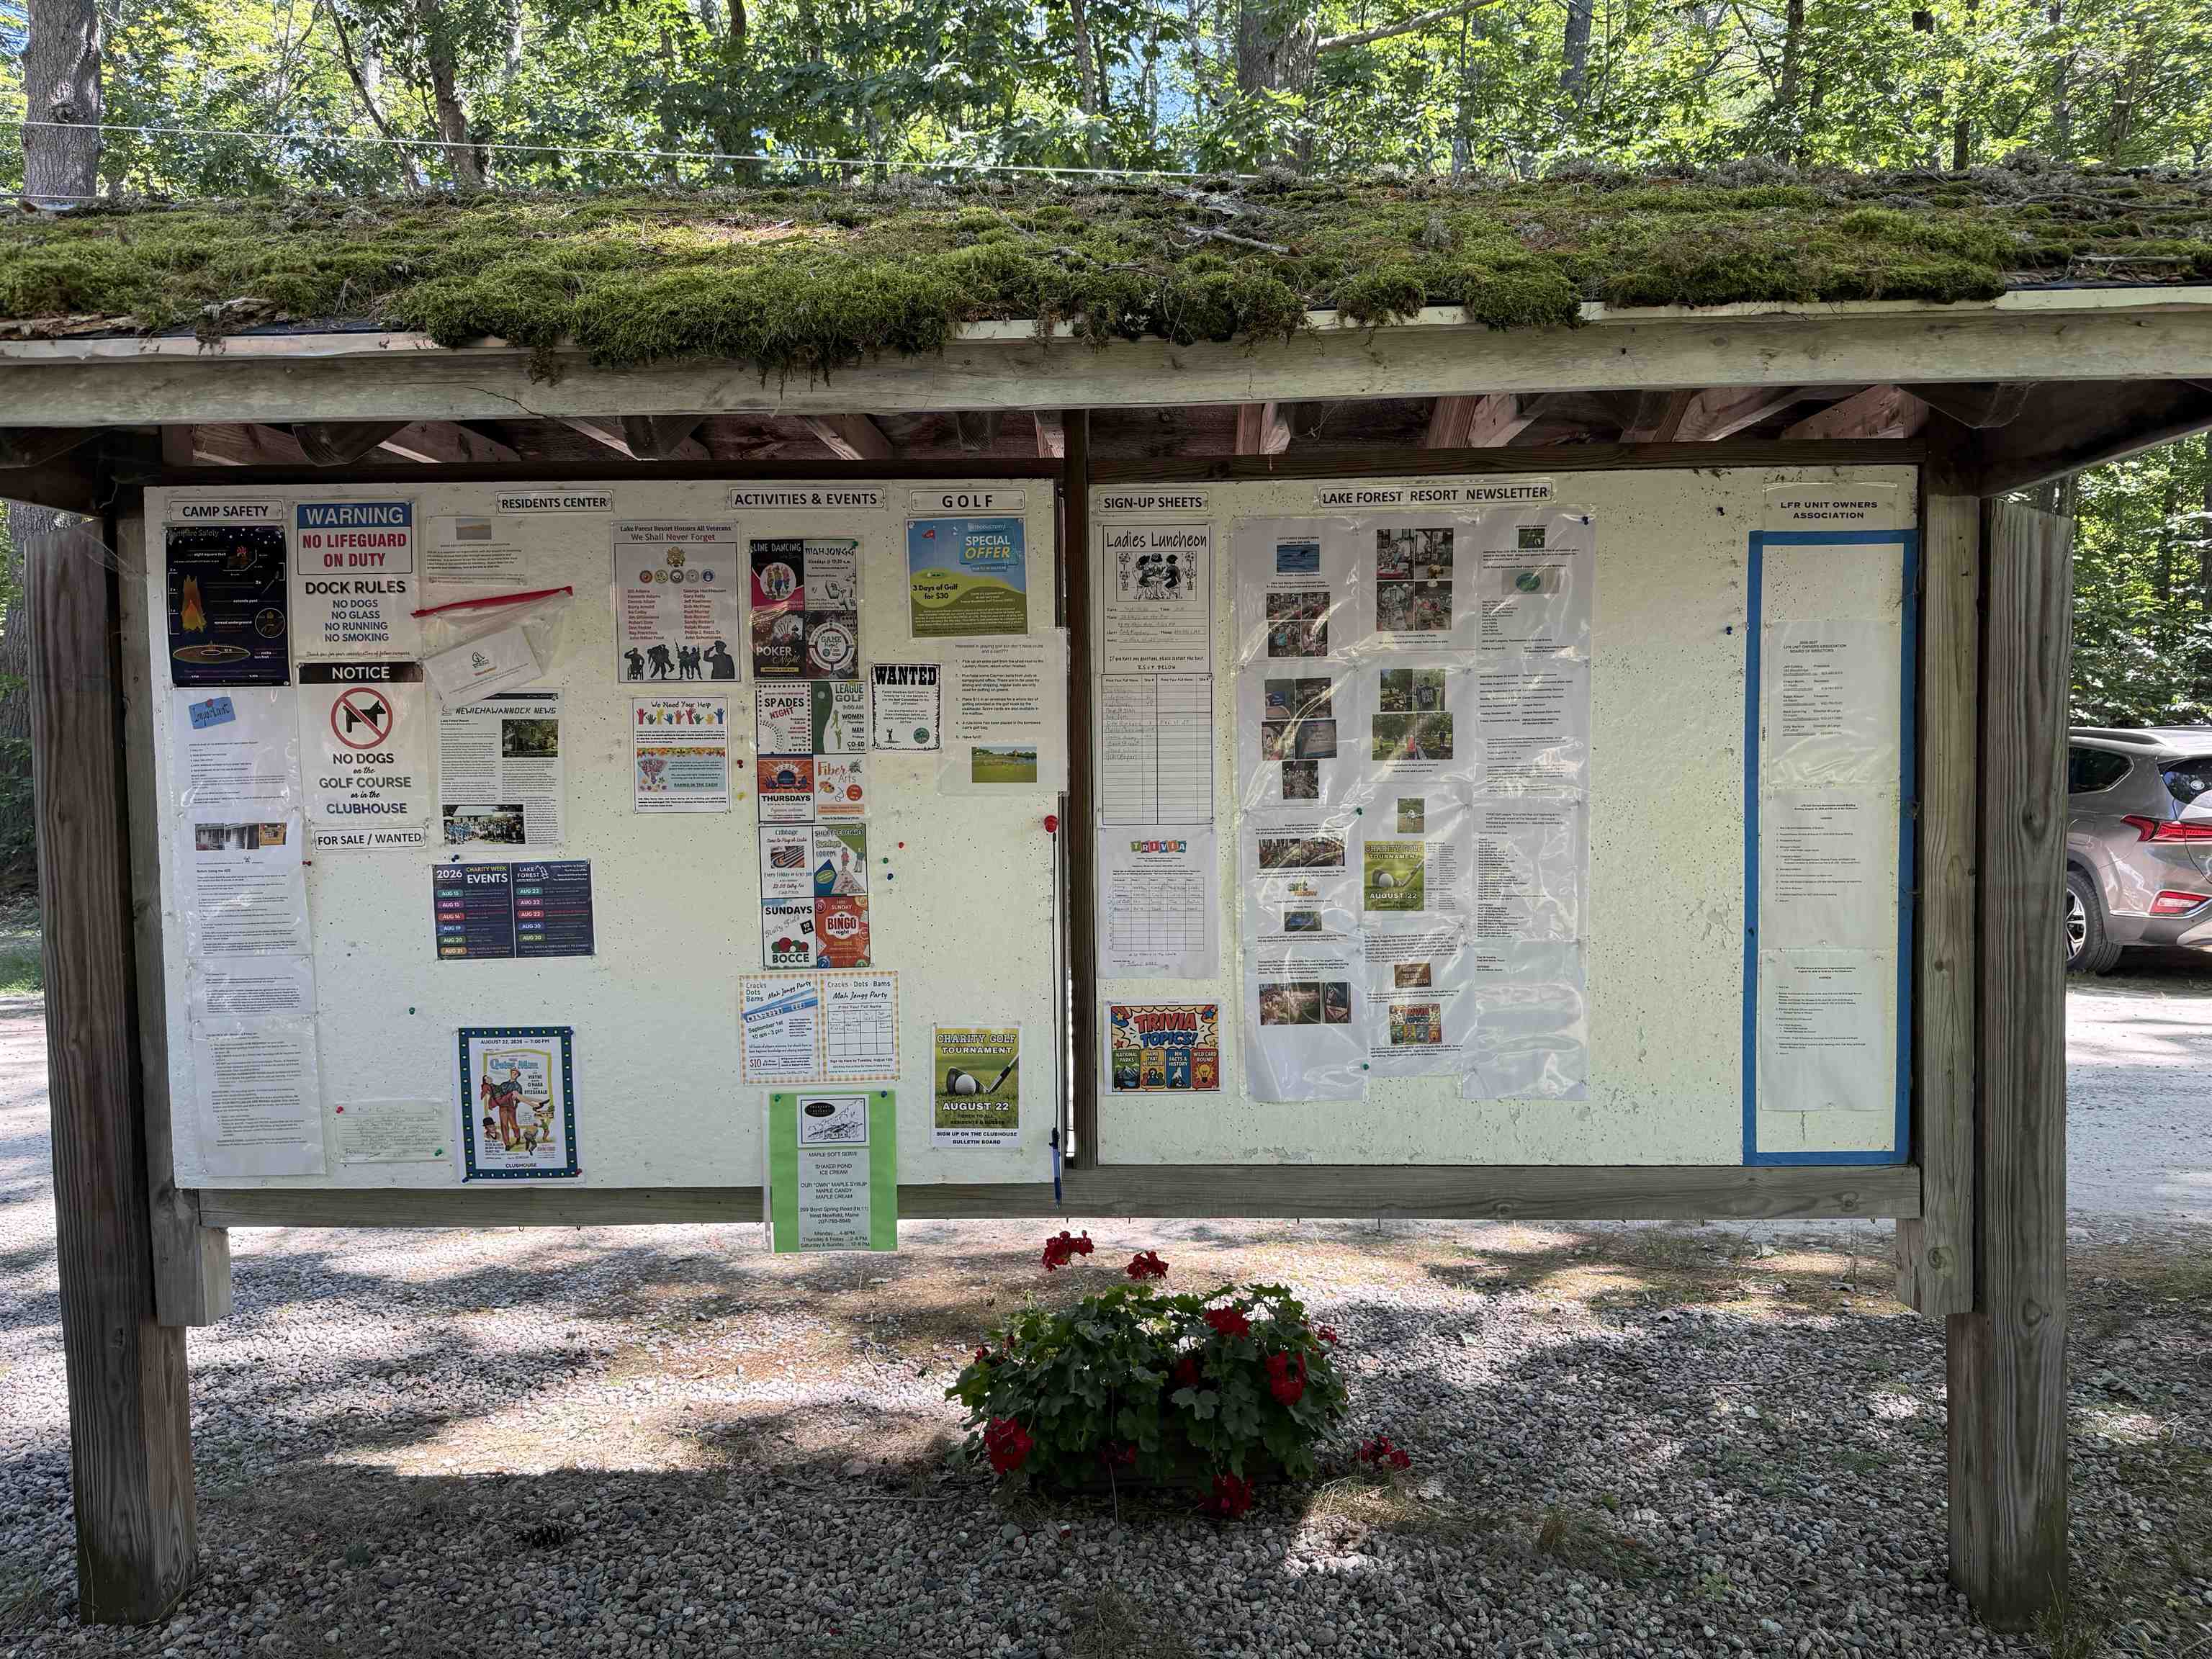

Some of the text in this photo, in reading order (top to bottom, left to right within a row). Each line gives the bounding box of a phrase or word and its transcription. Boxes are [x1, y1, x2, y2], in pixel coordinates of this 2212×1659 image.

[735, 493, 876, 505] ACTIVITIES & EVENTS
[1323, 487, 1547, 504] LAKE FOREST RESORT NEWSLETTER
[502, 498, 606, 508] RESIDENTS CENTER
[943, 495, 993, 508] GOLF
[1104, 497, 1202, 508] SIGN-UP SHEETS
[182, 506, 268, 517] CAMP SAFETY
[306, 507, 403, 524] WARNING
[302, 534, 407, 548] NO LIFEGUARD
[966, 536, 1010, 546] SPECIAL
[1106, 531, 1207, 547] Ladies Luncheon
[771, 543, 801, 552] DANCING
[965, 547, 1010, 559] OFFER
[323, 553, 385, 567] ON DUTY
[305, 580, 406, 594] DOCK RULES
[325, 621, 388, 631] NO RUNNING
[342, 633, 390, 642] SMOKING
[756, 647, 793, 657] POKER
[332, 666, 390, 679] NOTICE
[875, 666, 937, 685] WANTED
[835, 685, 863, 694] LEAGUE
[765, 698, 804, 707] SPADES
[193, 702, 230, 726] Important
[769, 708, 794, 719] NIGHT
[333, 752, 394, 764] NO DOGS
[319, 776, 411, 788] GOLF COURSE
[839, 775, 856, 783] Arts
[327, 803, 407, 814] CLUBHOUSE
[318, 834, 421, 845] FOR SALE / WANTED
[1132, 842, 1187, 852] TRIVIA
[436, 869, 462, 878] 2026
[467, 873, 508, 884] EVENTS
[828, 917, 856, 930] BINGO
[772, 953, 809, 963] BOCCE
[796, 981, 811, 990] Party
[1134, 1013, 1197, 1034] TRIVIA
[937, 1034, 1016, 1043] CHARITY GOLF
[1140, 1032, 1198, 1048] TOPICS!
[749, 1058, 761, 1068] $10
